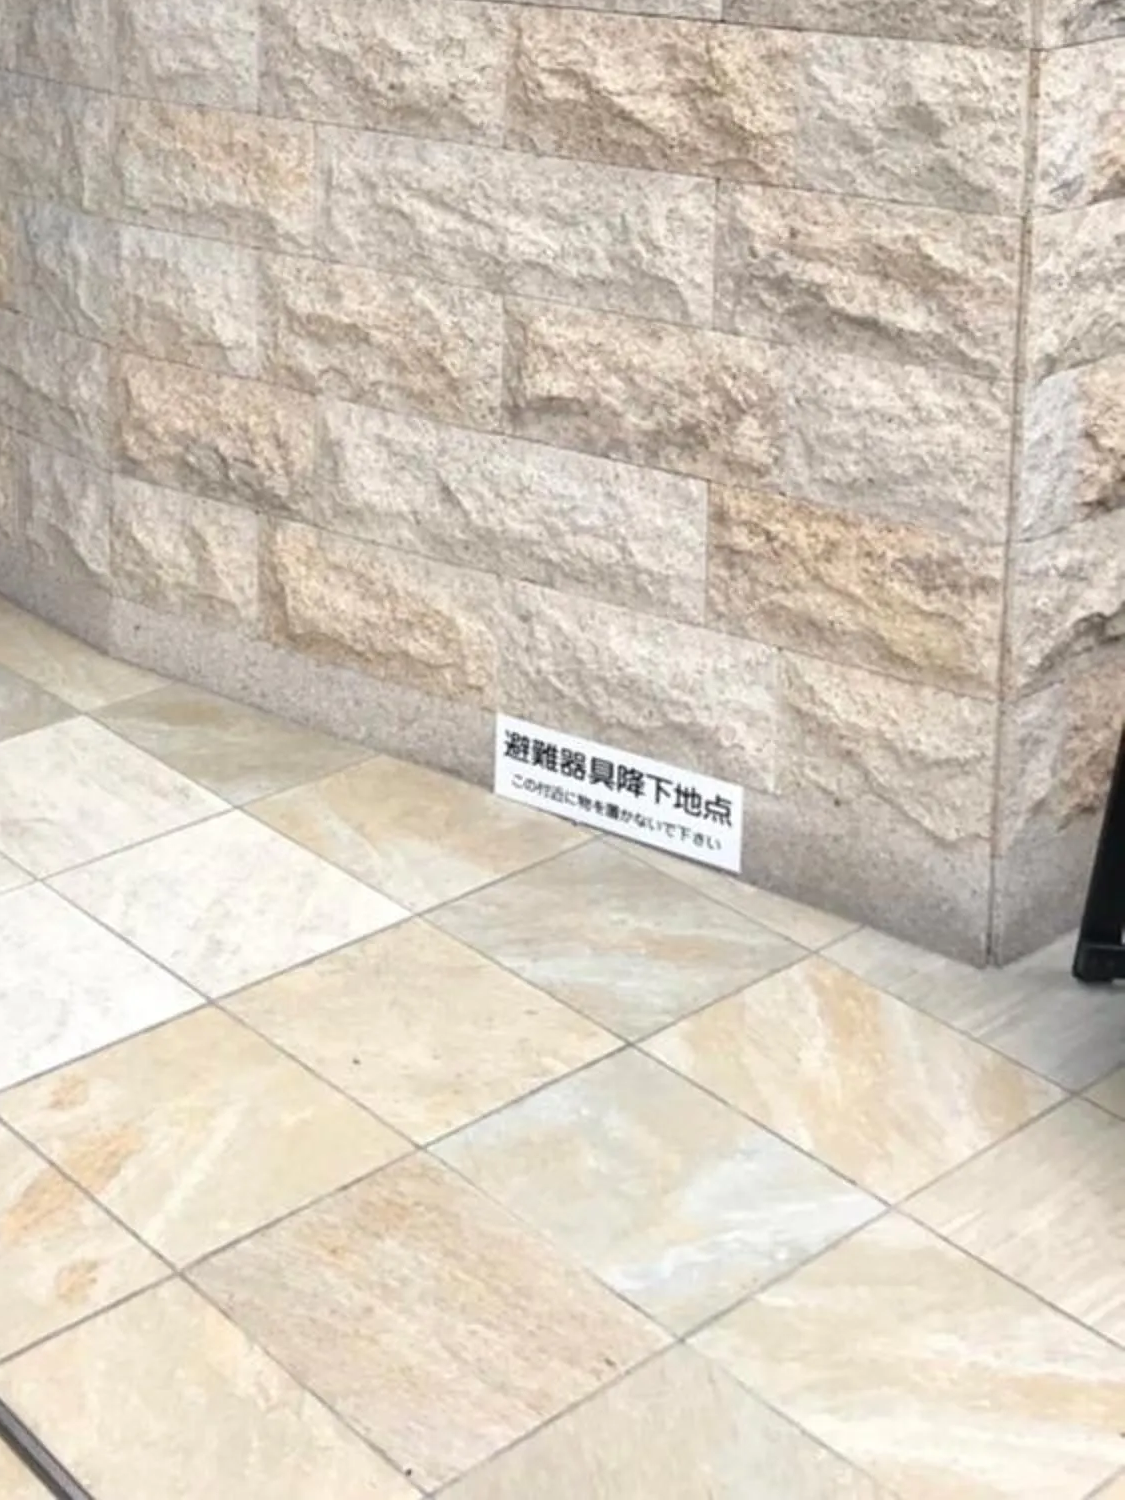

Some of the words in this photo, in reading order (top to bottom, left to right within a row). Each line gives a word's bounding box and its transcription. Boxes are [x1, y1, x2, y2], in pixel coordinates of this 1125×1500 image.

[504, 729, 733, 827] 避難器具降下地点
[511, 773, 722, 851] この付近に物を置かないで下さい
